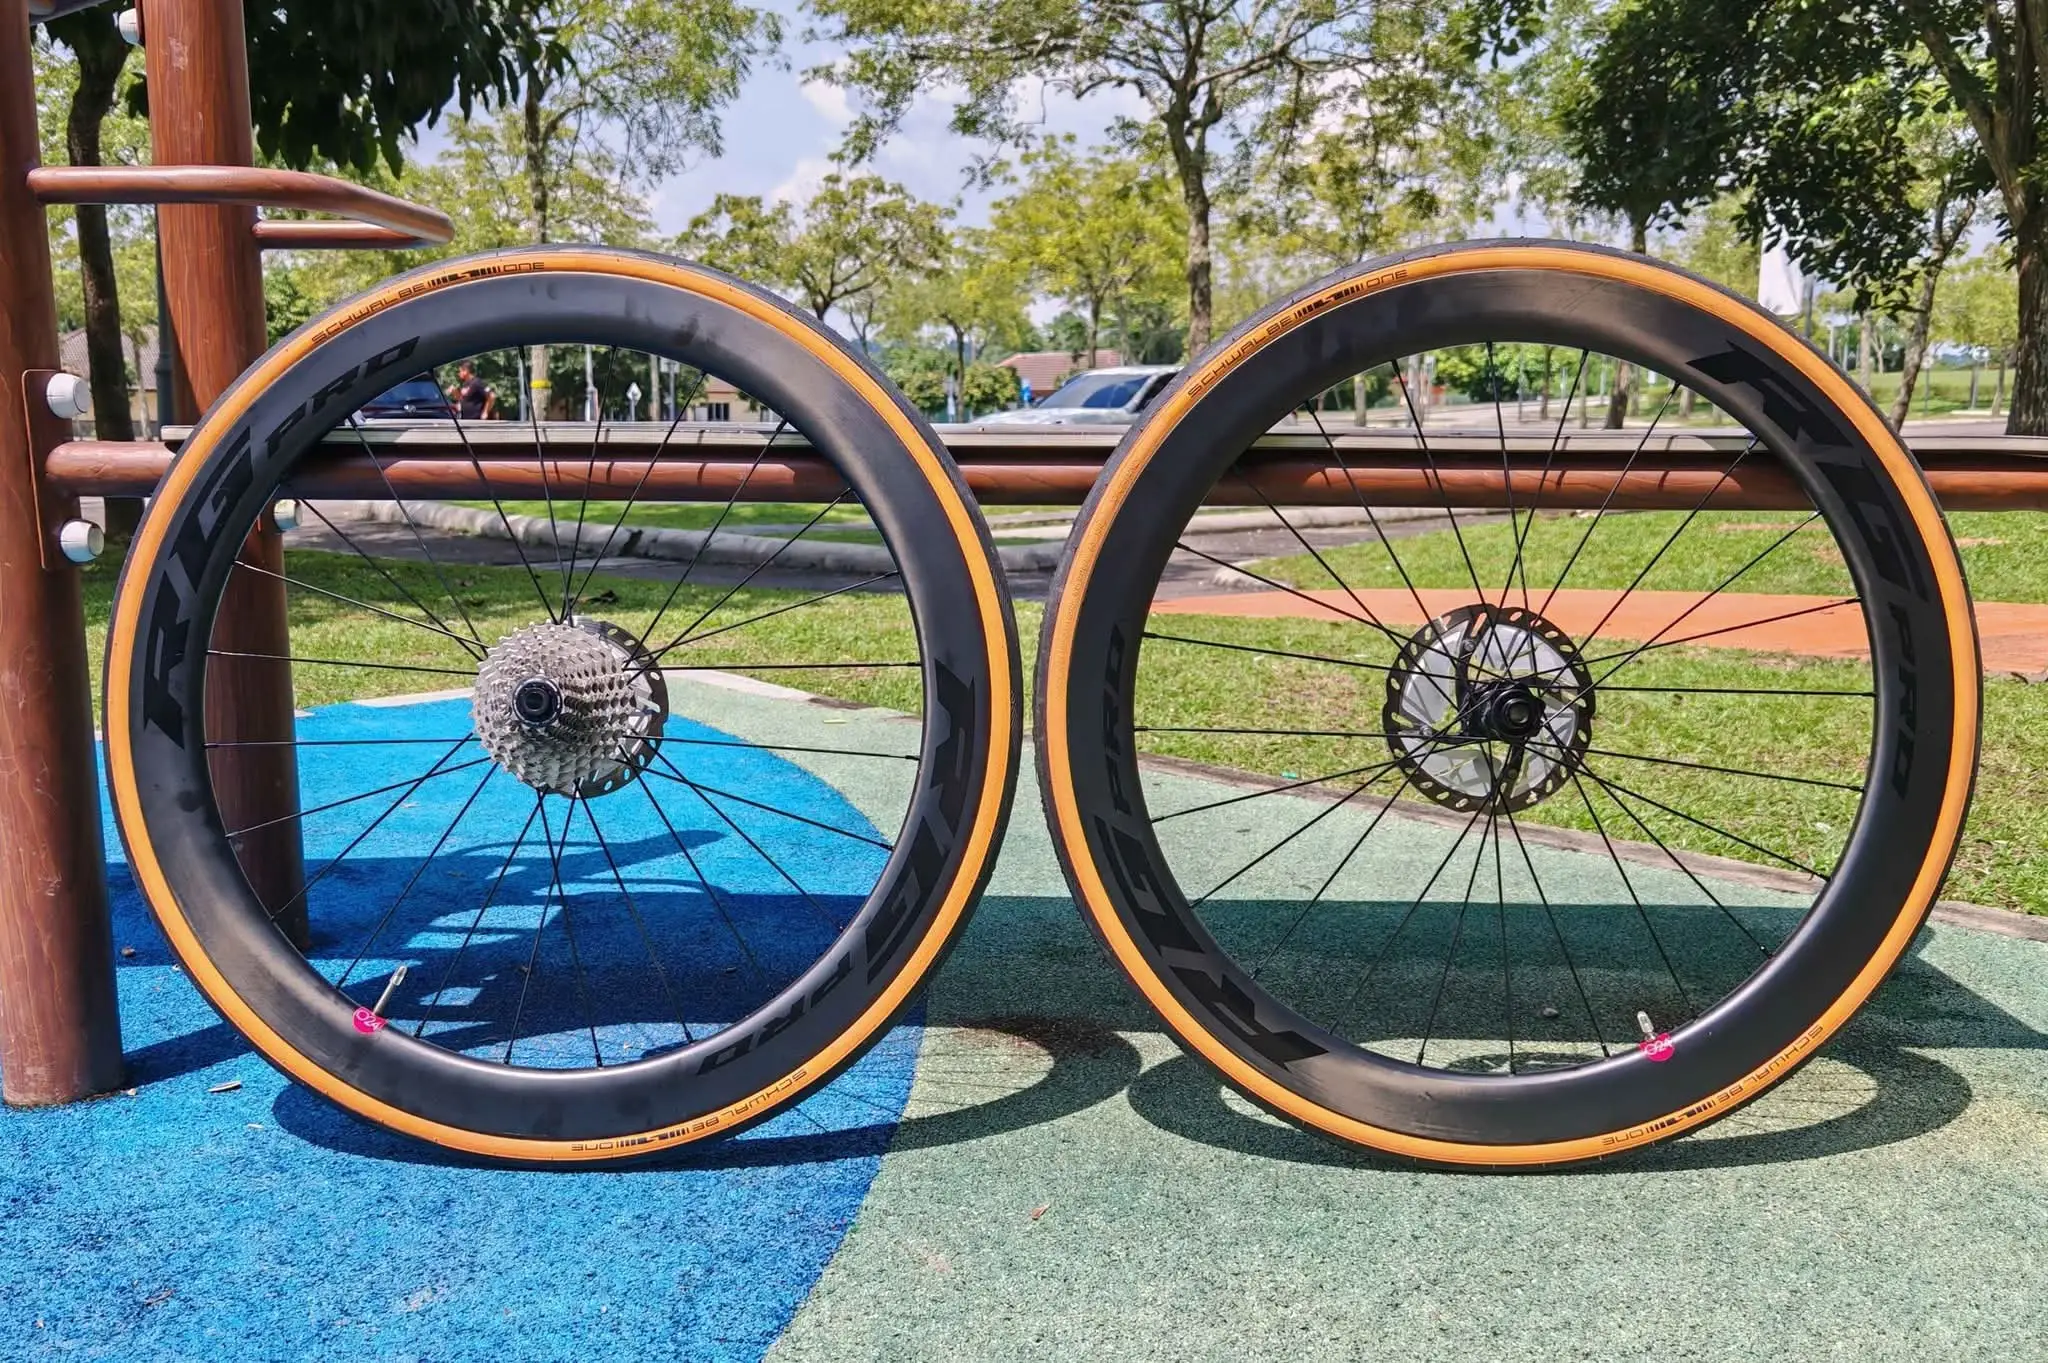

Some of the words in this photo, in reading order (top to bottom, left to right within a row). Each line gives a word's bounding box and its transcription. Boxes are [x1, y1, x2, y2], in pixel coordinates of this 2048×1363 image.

[311, 282, 425, 344] SCHWALBE
[503, 261, 545, 272] ONE
[1187, 316, 1293, 399] SCHWALBE
[1366, 269, 1408, 289] ONE
[266, 335, 420, 459] PRO
[1102, 622, 1133, 817] PRO
[1887, 601, 1917, 800] PRO
[698, 951, 855, 1074] PRO
[1717, 1025, 1824, 1103] SCHWALBE
[571, 1142, 614, 1152] ONE
[692, 1068, 808, 1133] SCHWALBE
[1602, 1128, 1644, 1146] ONE
